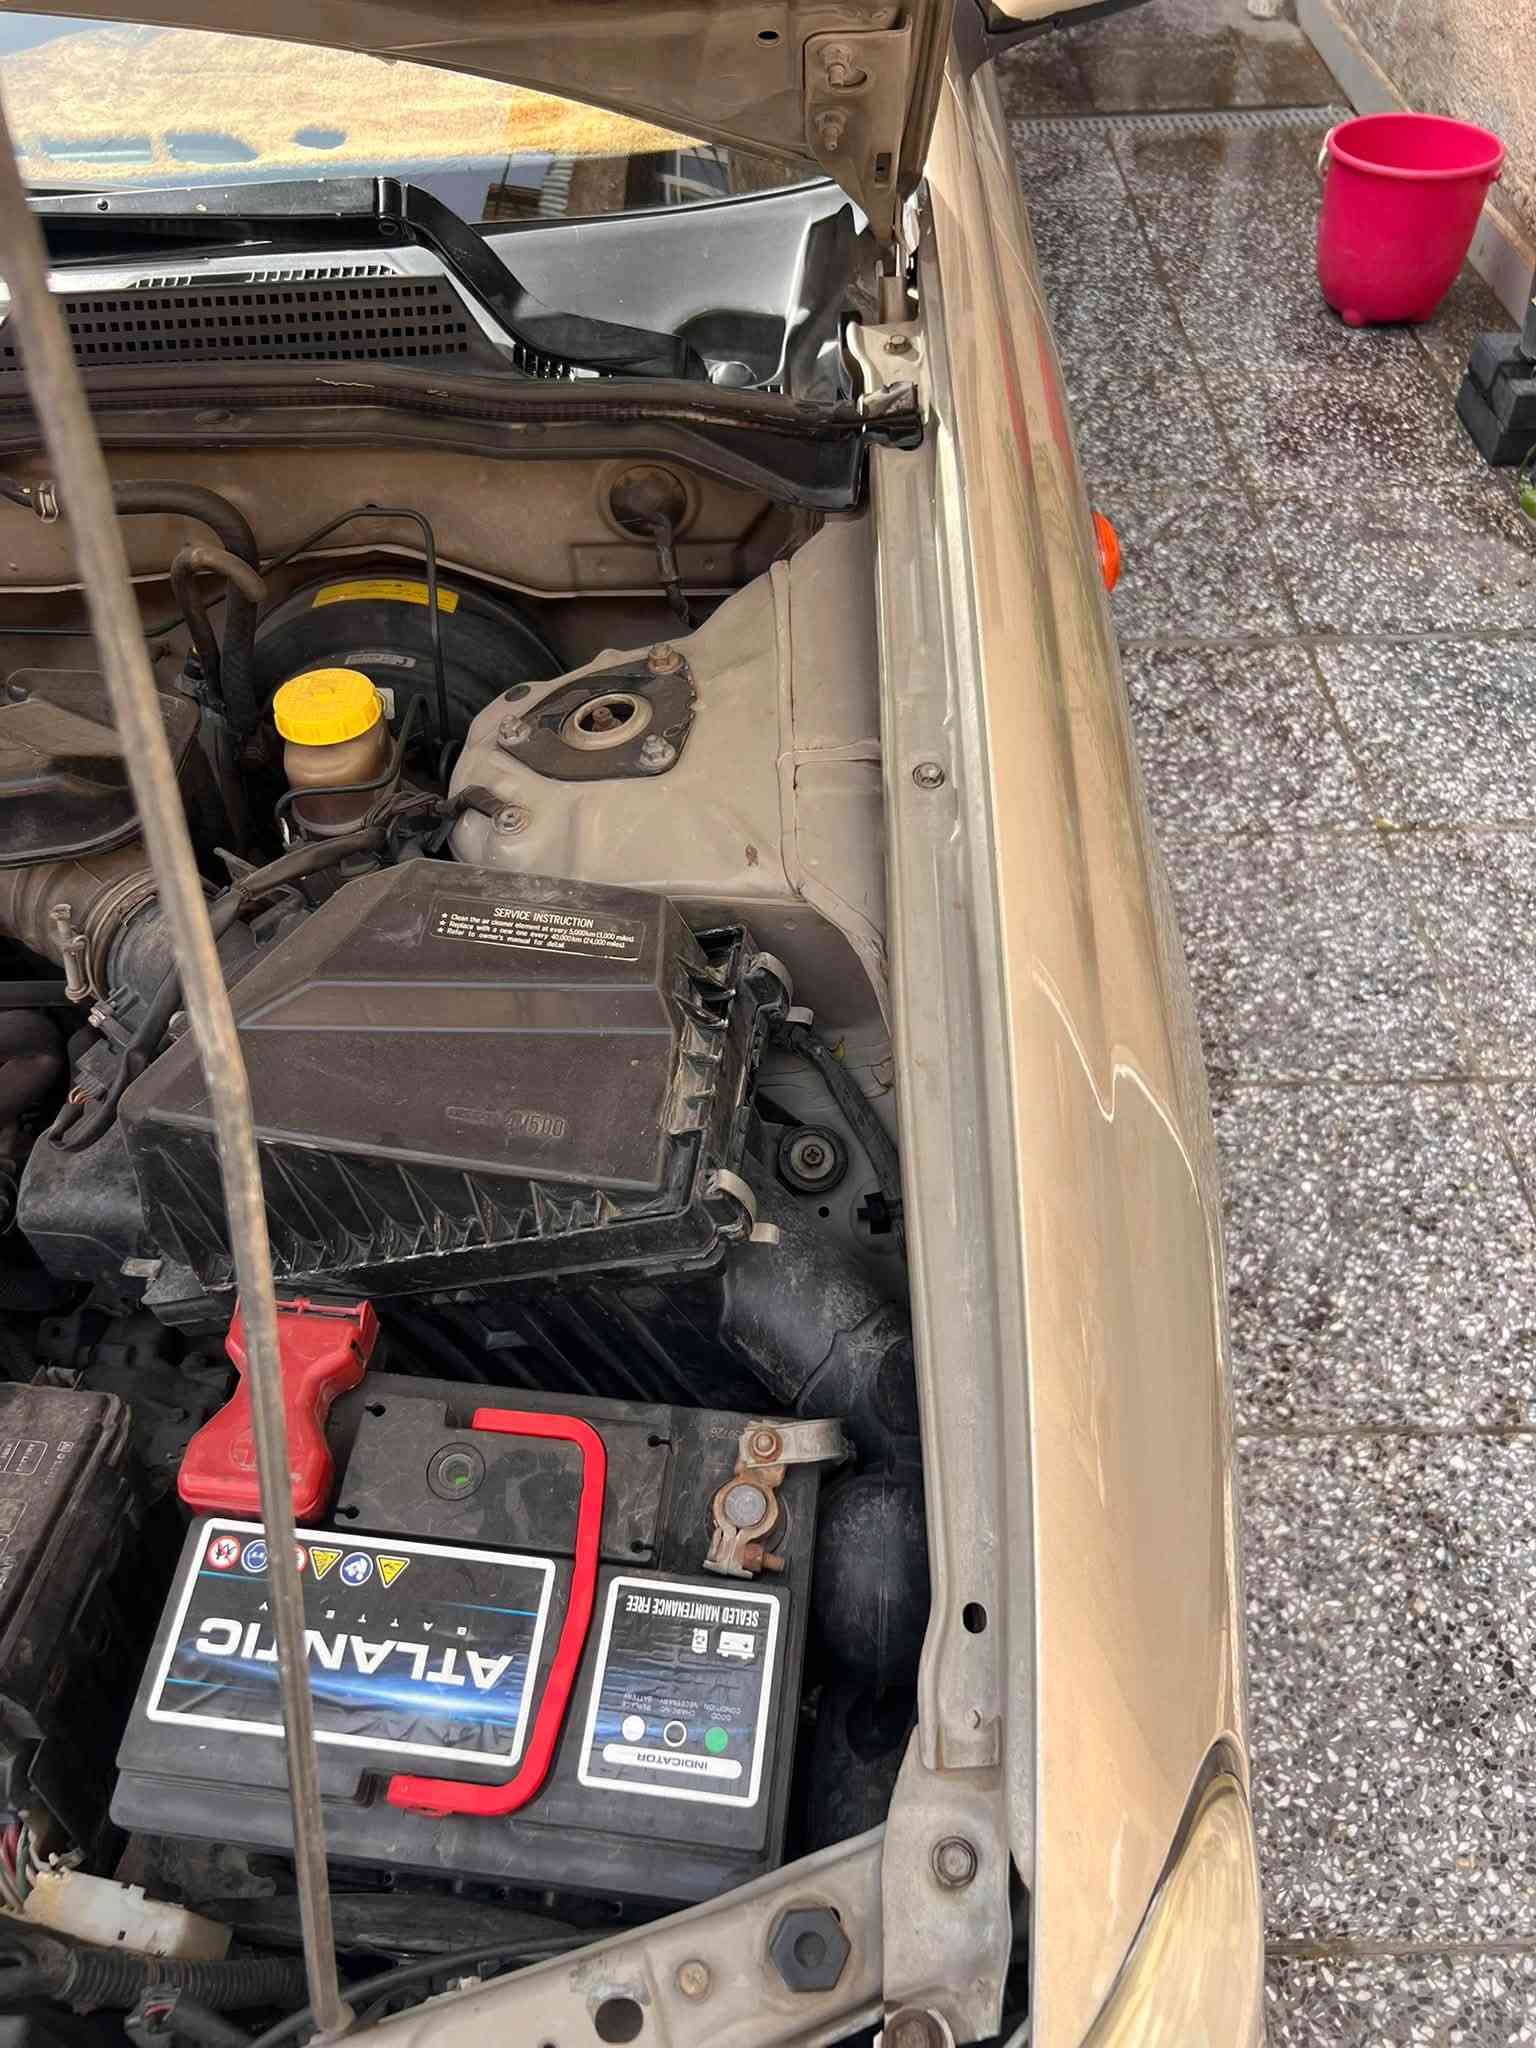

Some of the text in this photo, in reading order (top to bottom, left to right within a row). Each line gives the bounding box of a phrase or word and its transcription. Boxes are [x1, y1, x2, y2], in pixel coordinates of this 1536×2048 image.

[450, 913, 468, 922] Clean
[469, 915, 480, 923] the
[514, 922, 540, 930] element
[549, 927, 567, 935] every
[494, 908, 594, 928] SERVICE INSTRUCTION
[448, 920, 474, 929] Replace
[475, 924, 490, 932] with
[529, 931, 548, 940] every
[258, 1600, 468, 1637] BATTEY
[626, 1595, 759, 1627] SEALED MAINTENANCE FREE
[637, 1753, 708, 1770] INDICATOR
